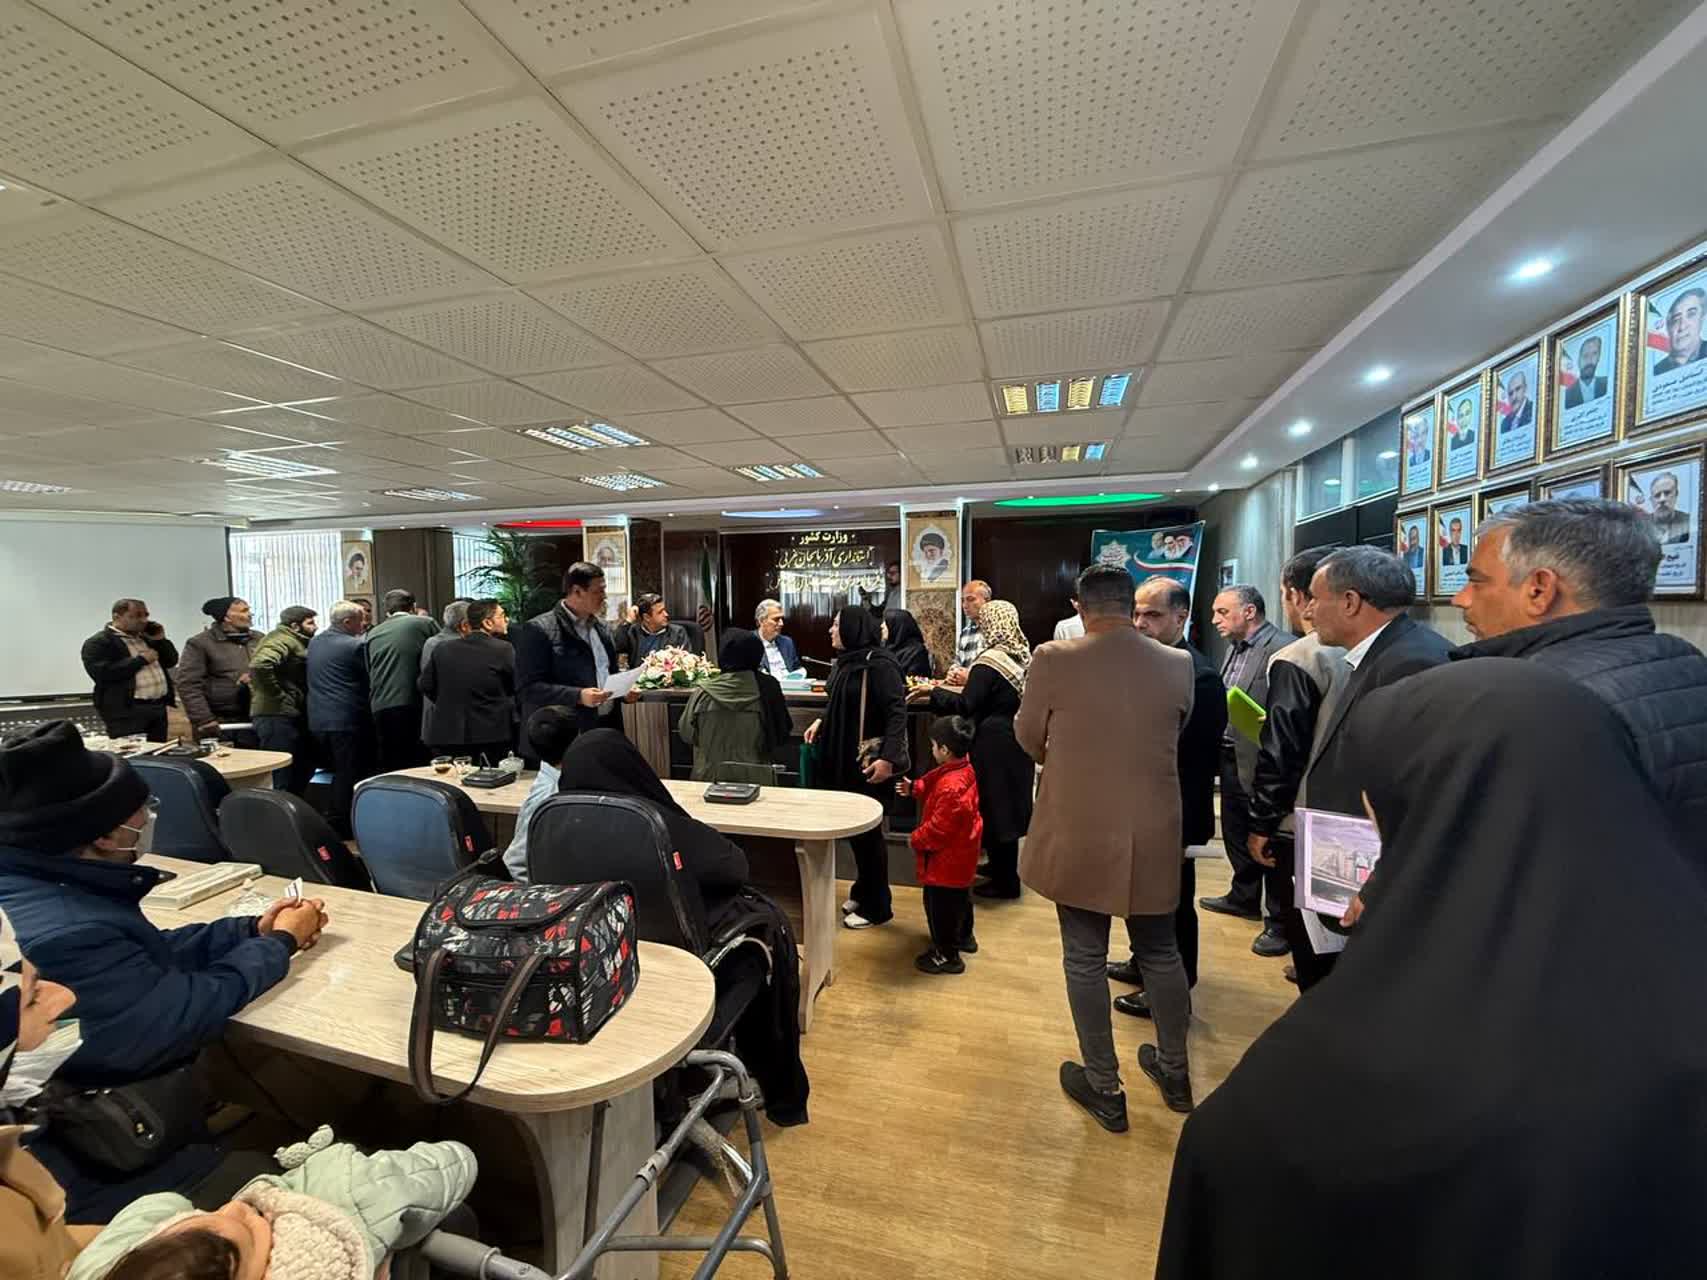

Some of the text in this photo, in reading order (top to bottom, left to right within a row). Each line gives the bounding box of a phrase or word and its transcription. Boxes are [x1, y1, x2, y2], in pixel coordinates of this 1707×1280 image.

[799, 530, 848, 545] وزارت کشور
[779, 547, 870, 569] استانداری آذربایجان غربی
